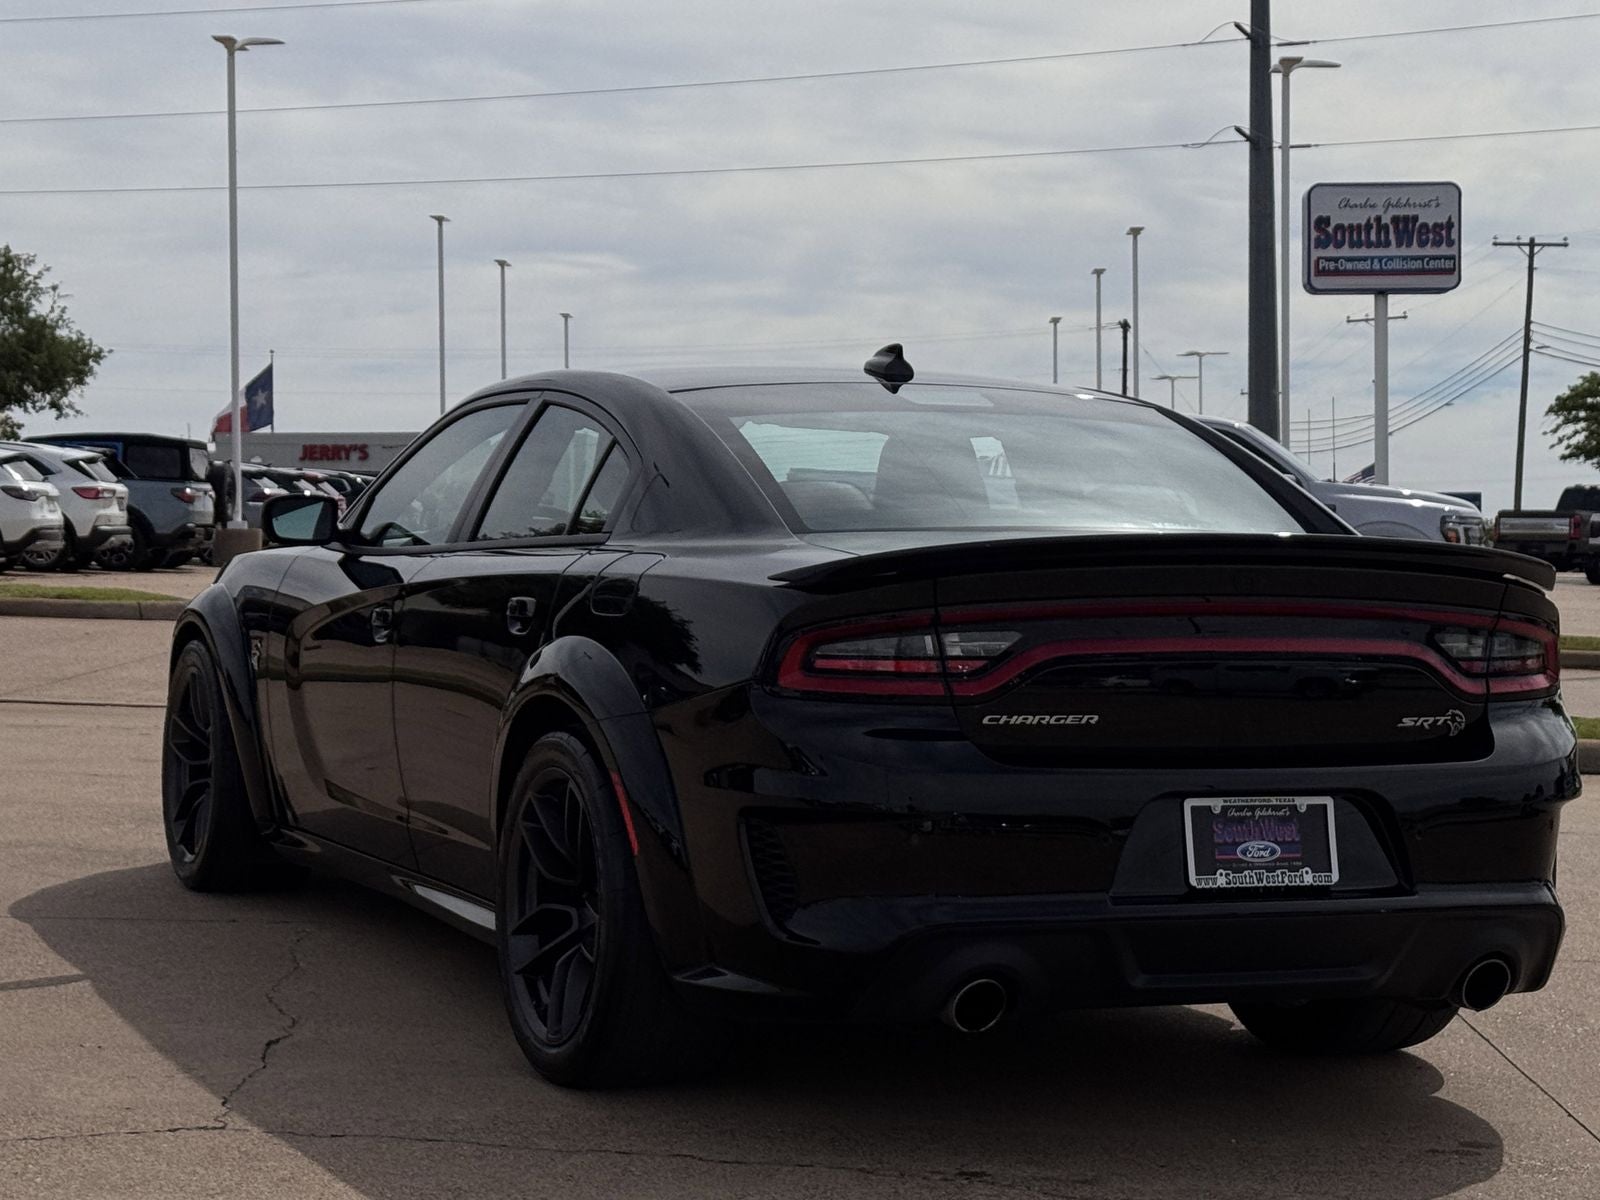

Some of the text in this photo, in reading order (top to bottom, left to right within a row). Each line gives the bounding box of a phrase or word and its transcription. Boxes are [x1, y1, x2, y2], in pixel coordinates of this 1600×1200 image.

[1337, 196, 1440, 214] Charlie Gilchrist's
[1313, 214, 1455, 249] SouthWest
[1318, 256, 1455, 271] Pre-Owned & Collision Center
[299, 443, 370, 461] JERRY'S
[982, 715, 1099, 725] CHARGER
[1397, 716, 1451, 730] SRT
[1246, 844, 1271, 857] Ford
